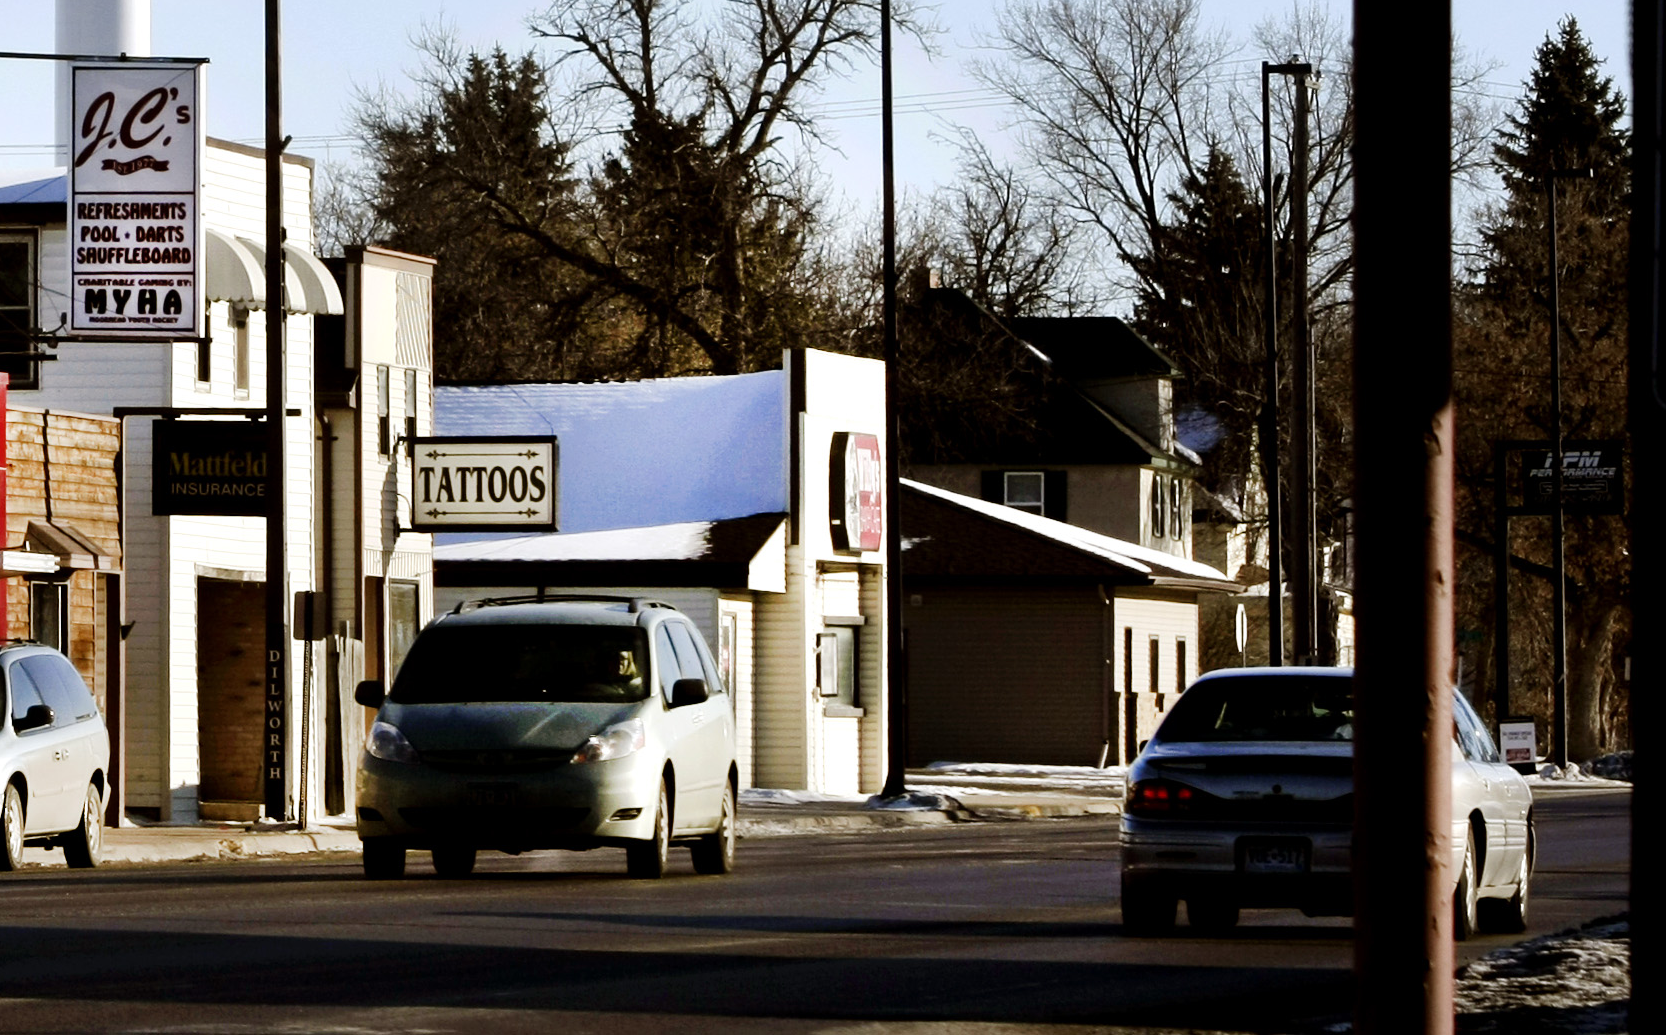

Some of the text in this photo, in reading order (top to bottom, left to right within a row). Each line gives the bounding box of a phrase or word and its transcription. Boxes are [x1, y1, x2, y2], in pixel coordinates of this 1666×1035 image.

[77, 202, 186, 220] REFRESHMENTS
[80, 225, 185, 243] POOL DARTS
[76, 246, 192, 264] SHUFFLEBOARD
[84, 289, 183, 315] MYHA
[169, 450, 267, 477] Mattfeld
[171, 482, 266, 497] INSURANCE
[419, 465, 546, 503] TATTOOS
[267, 649, 283, 780] DILWORTH
